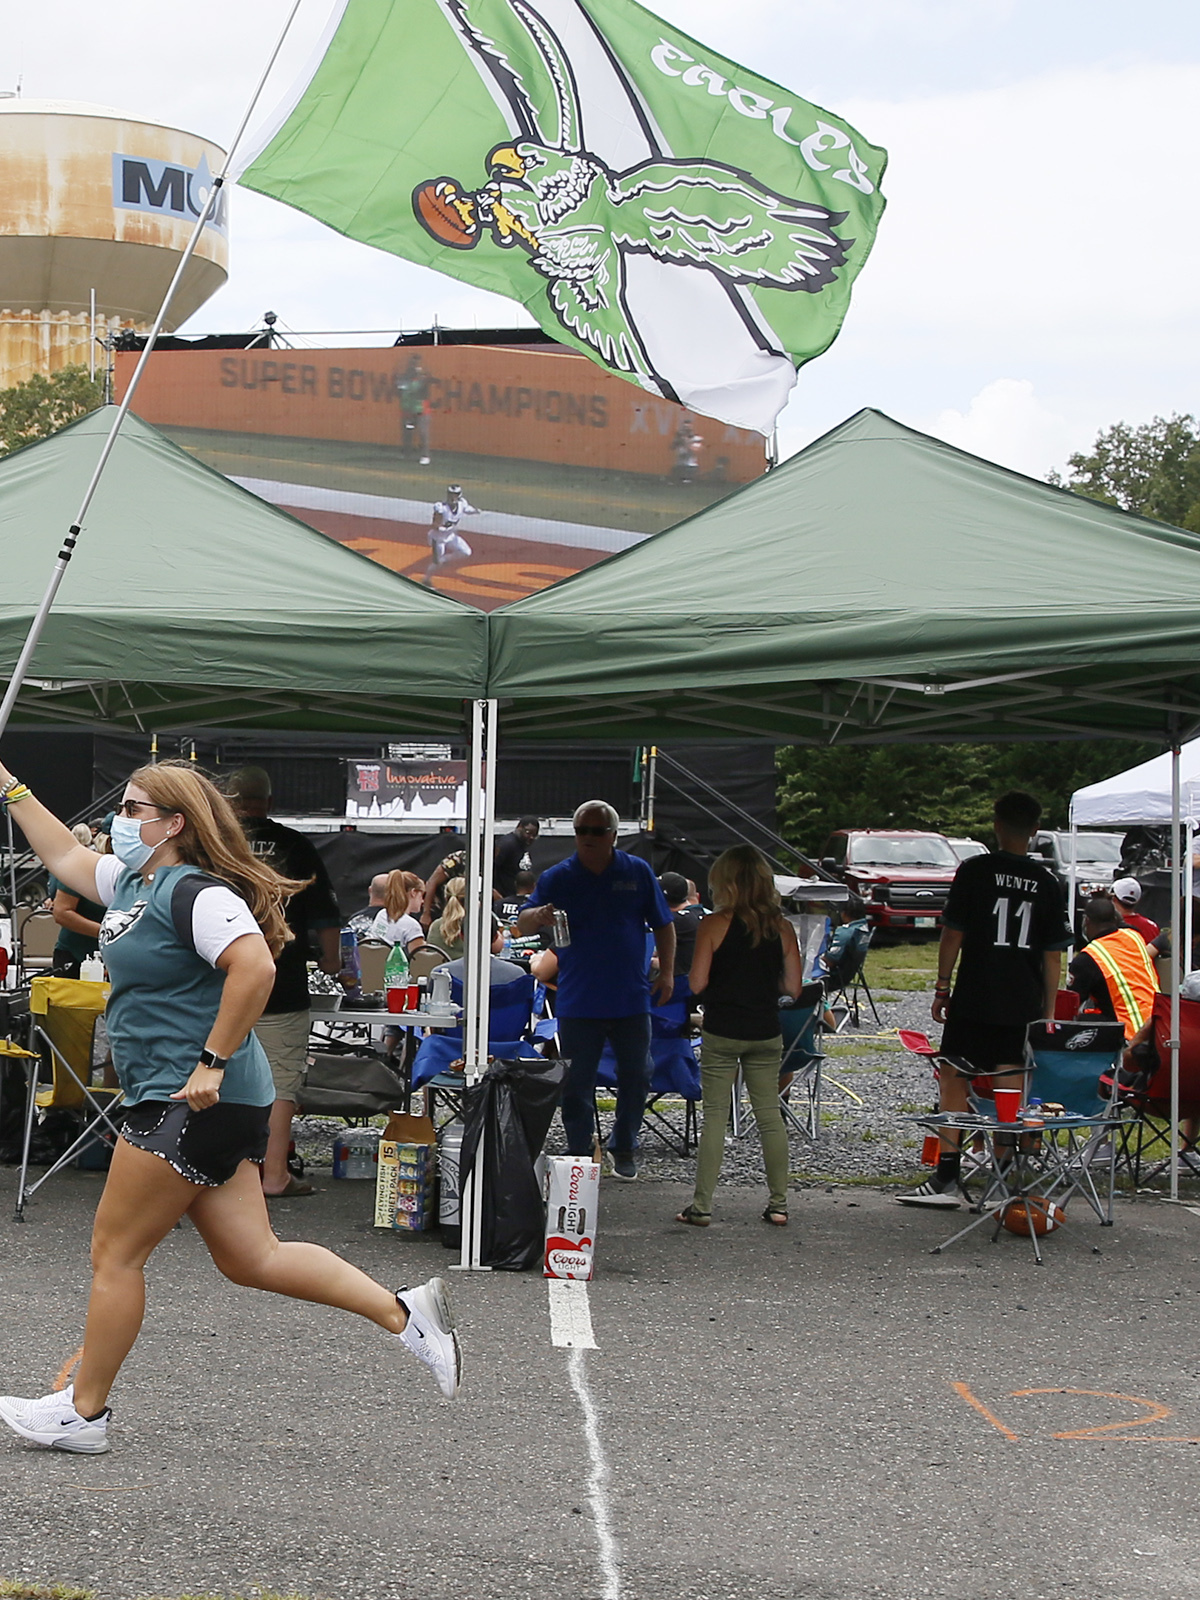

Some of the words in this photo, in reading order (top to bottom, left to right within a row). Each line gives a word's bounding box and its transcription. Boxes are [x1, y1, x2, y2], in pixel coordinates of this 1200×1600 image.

[220, 356, 320, 397] SUPER
[327, 366, 405, 405] BOW
[428, 378, 609, 429] CHAMPIONS
[385, 766, 457, 784] Innovative
[994, 873, 1039, 893] WENTZ
[502, 903, 519, 915] TEE
[992, 897, 1032, 949] 11
[383, 1146, 394, 1159] 15
[389, 1166, 398, 1189] PACK
[569, 1166, 584, 1200] Coors
[378, 1184, 386, 1212] FLYING
[387, 1190, 396, 1224] VARIETY
[567, 1202, 577, 1234] LIGHT
[552, 1252, 587, 1266] Coors
